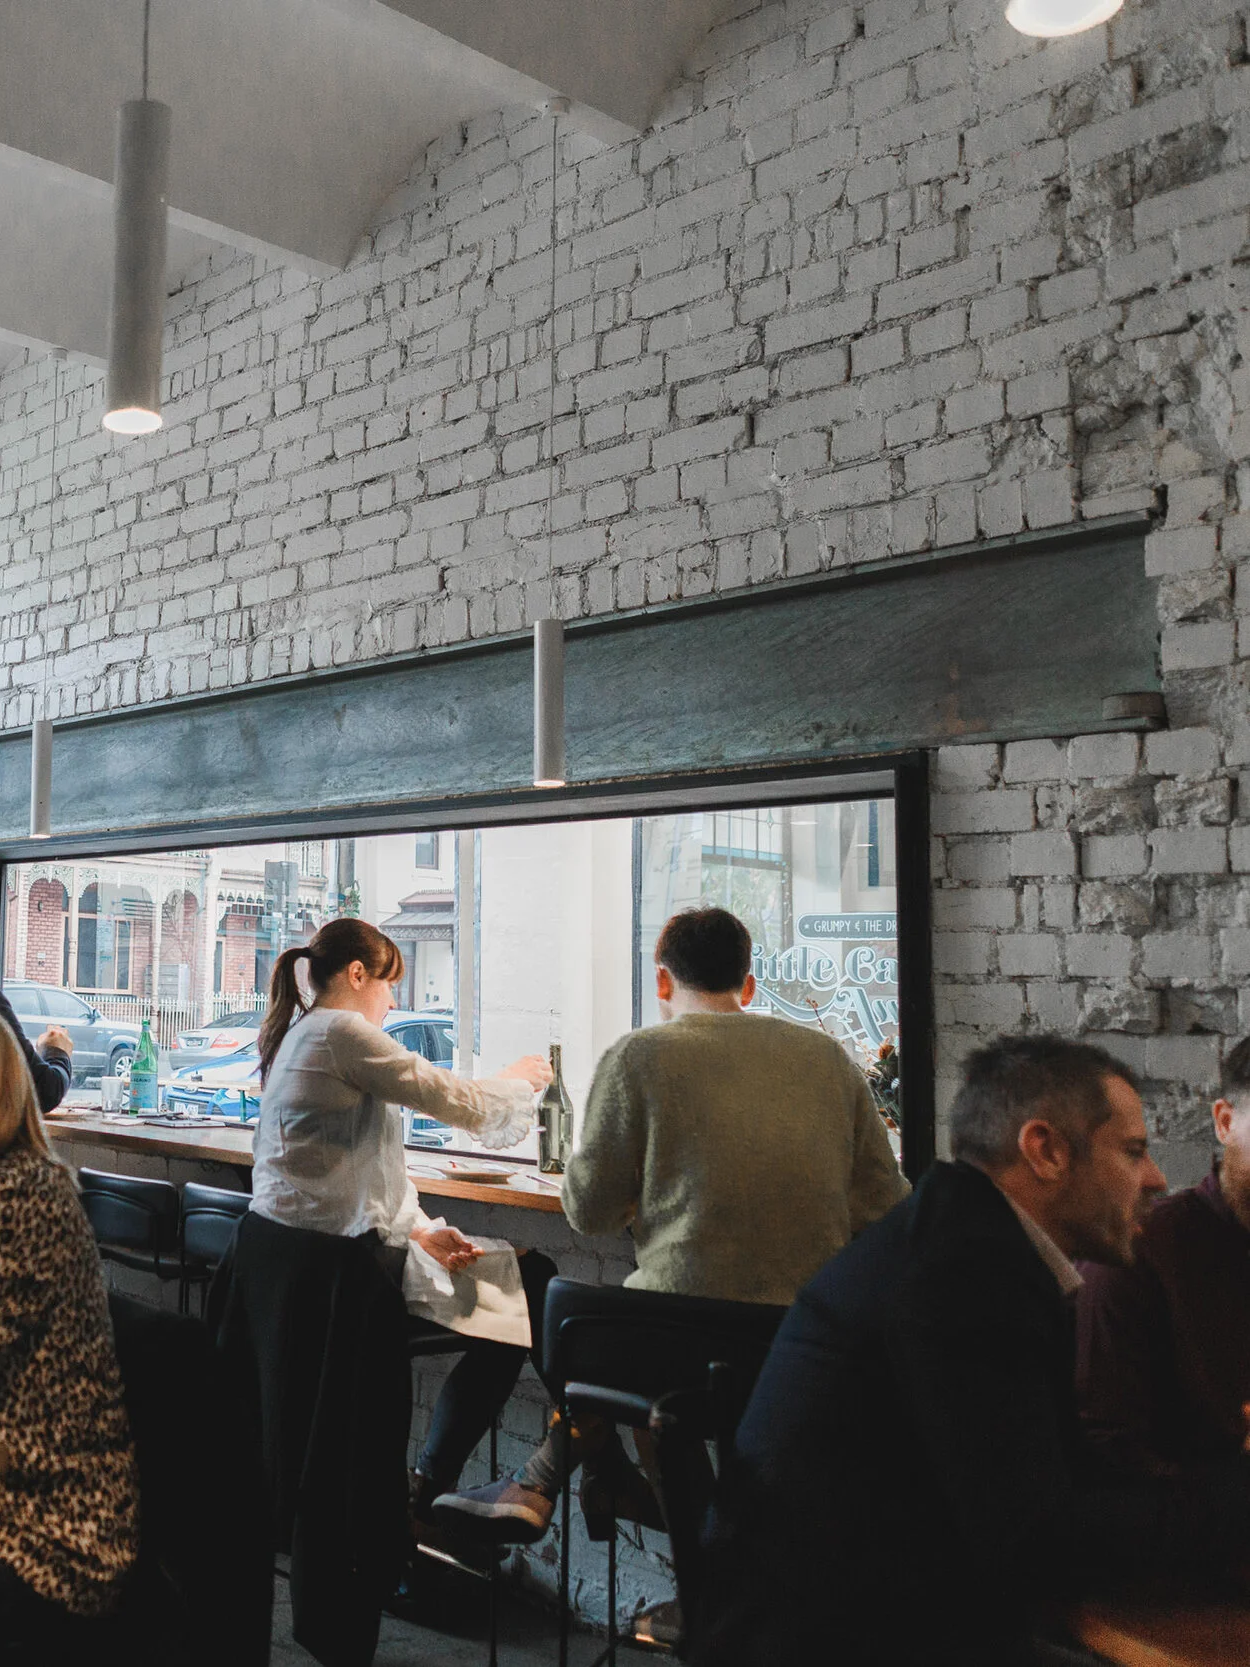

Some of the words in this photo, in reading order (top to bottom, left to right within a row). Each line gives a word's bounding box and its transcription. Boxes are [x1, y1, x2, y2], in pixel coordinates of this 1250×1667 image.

[813, 920, 851, 933] GRUMPY
[864, 919, 883, 932] THE
[751, 944, 838, 989] ittle
